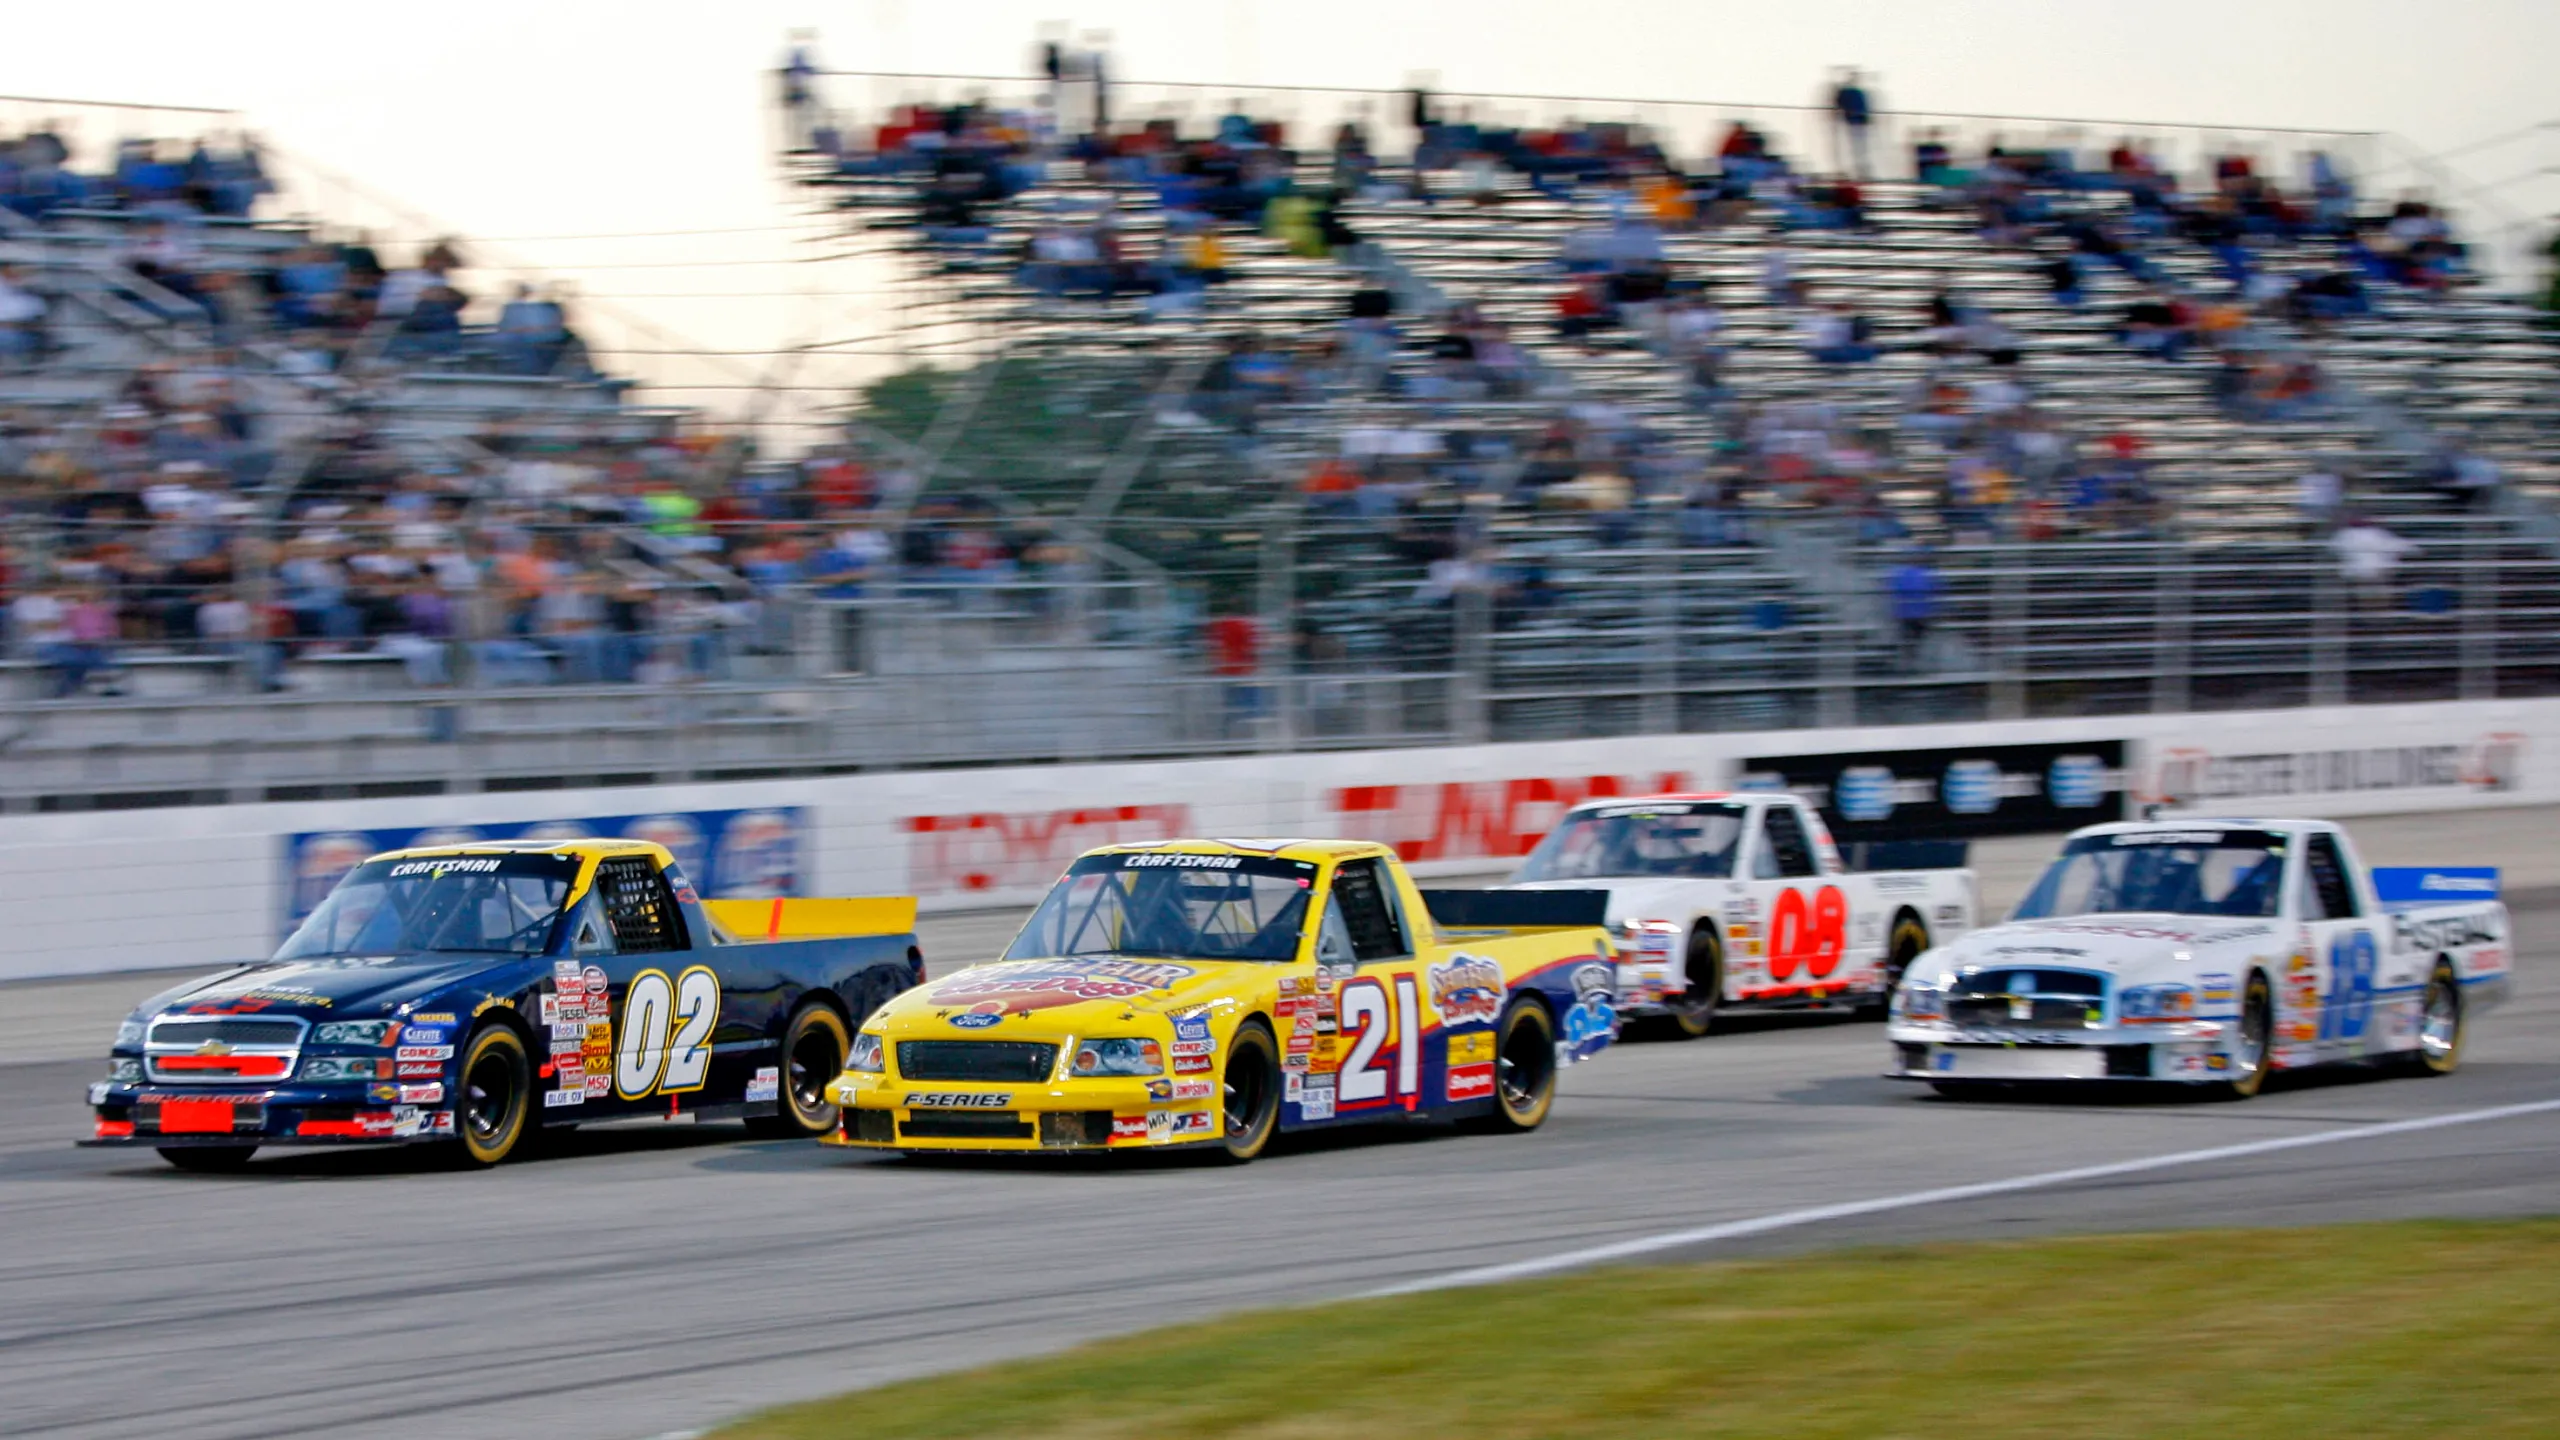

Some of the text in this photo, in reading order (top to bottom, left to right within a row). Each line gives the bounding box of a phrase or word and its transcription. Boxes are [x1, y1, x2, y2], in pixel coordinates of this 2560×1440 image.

[390, 859, 501, 877] CRAFTSMAN
[1124, 854, 1242, 869] CRAFTSMAN
[955, 1012, 994, 1028] Ford
[404, 1027, 441, 1041] CLEVITE
[616, 964, 722, 1101] 02
[1337, 973, 1424, 1111] 21
[587, 1077, 609, 1090] MSD
[902, 1092, 1012, 1107] F-SERIES
[418, 1112, 451, 1130] JE
[1148, 1112, 1168, 1130] WIX
[1172, 1112, 1208, 1131] JE
